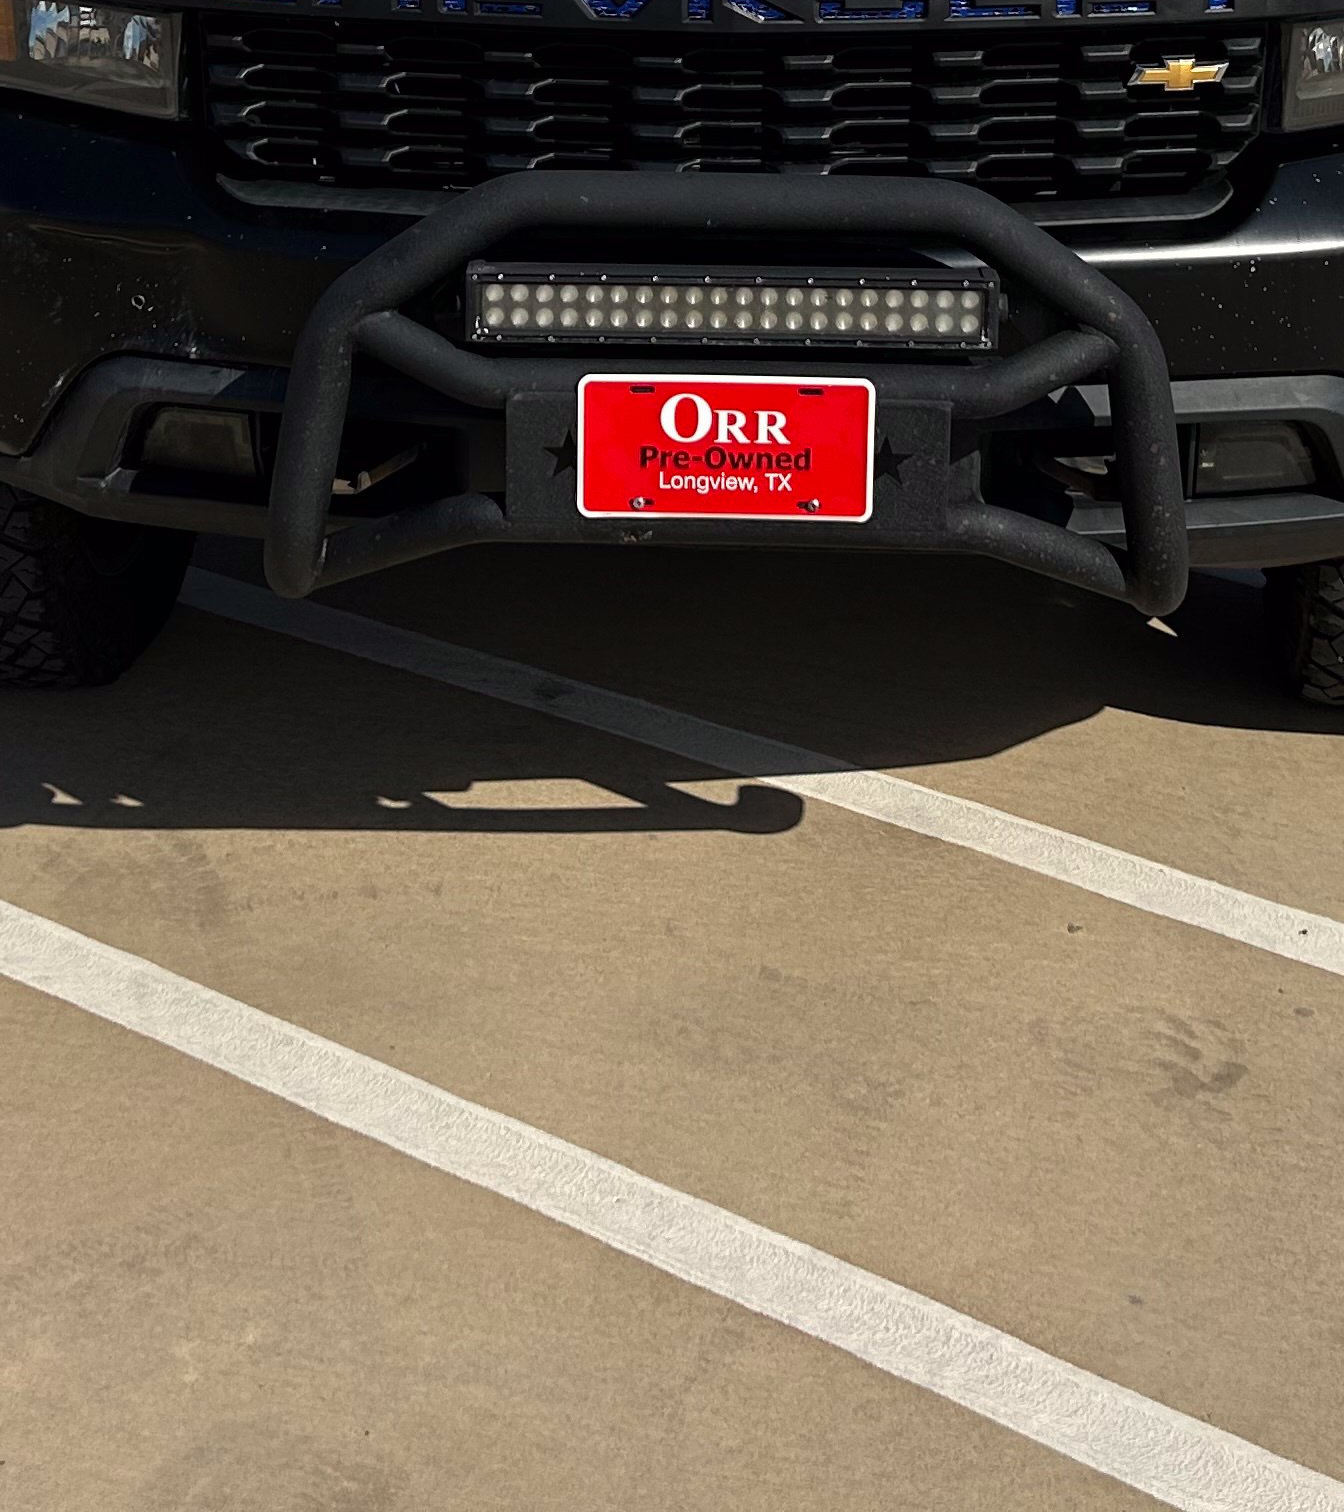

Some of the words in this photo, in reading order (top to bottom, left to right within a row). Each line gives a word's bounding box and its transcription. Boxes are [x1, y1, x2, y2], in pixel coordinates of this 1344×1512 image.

[639, 445, 812, 472] Pre-Owned
[658, 471, 760, 494] Longview,
[764, 472, 793, 492] TX
